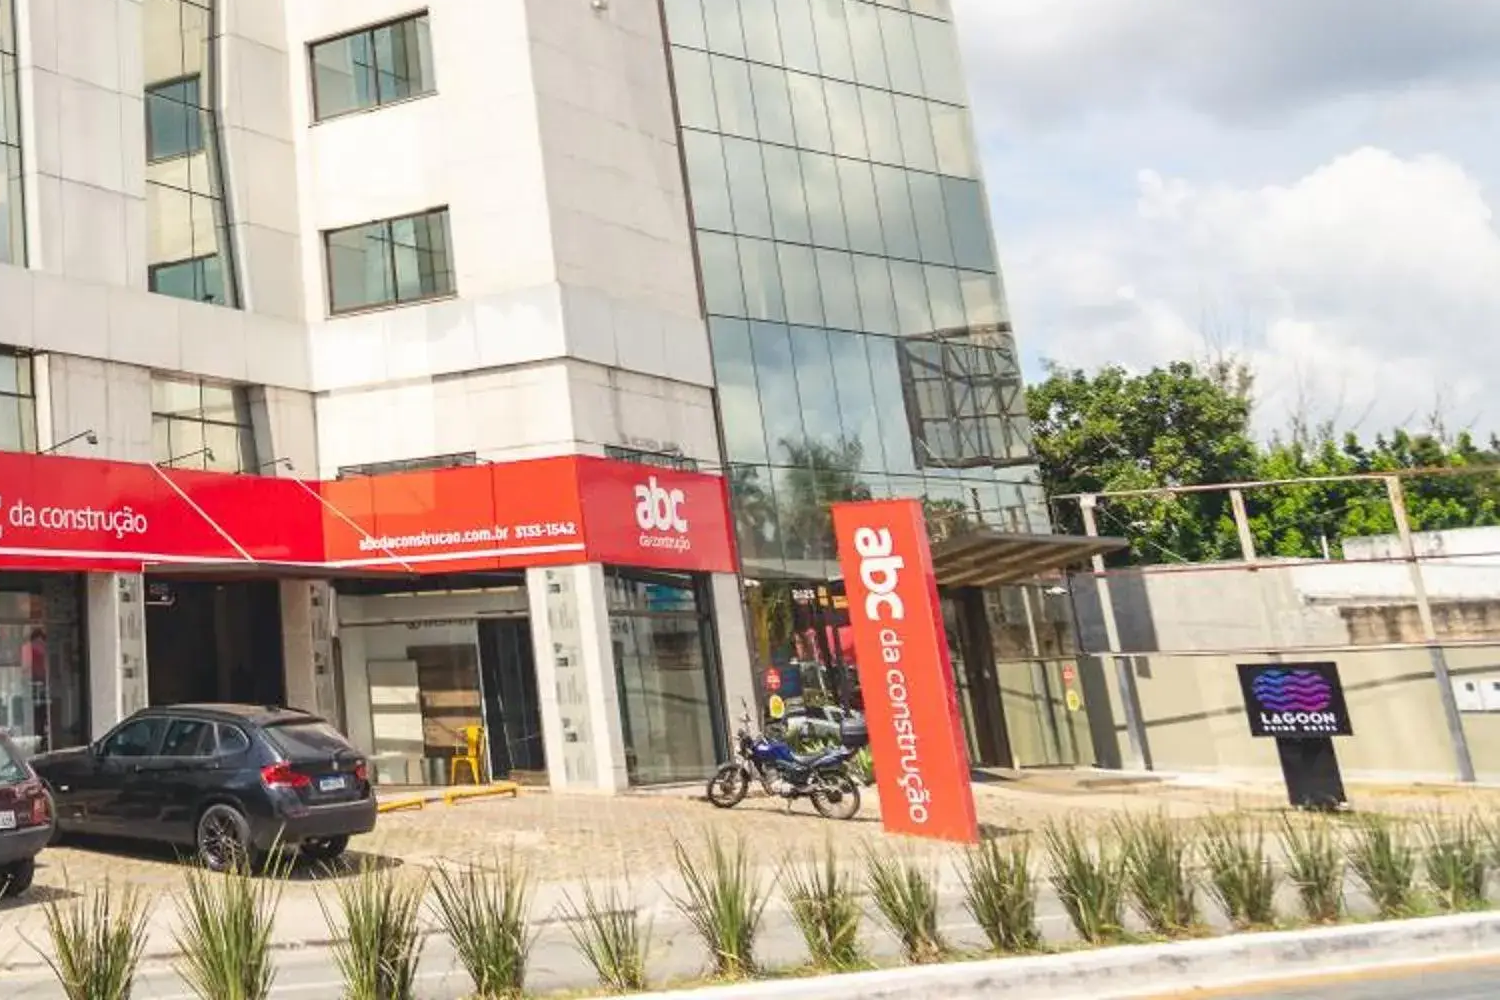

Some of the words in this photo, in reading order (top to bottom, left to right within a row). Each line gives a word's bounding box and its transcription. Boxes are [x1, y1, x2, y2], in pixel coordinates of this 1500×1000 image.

[9, 500, 36, 527] da
[40, 506, 148, 539] construção
[634, 475, 688, 533] abc
[855, 527, 905, 621] abc
[879, 628, 904, 663] da
[1260, 712, 1336, 725] LAGOON
[886, 669, 931, 824] construção
